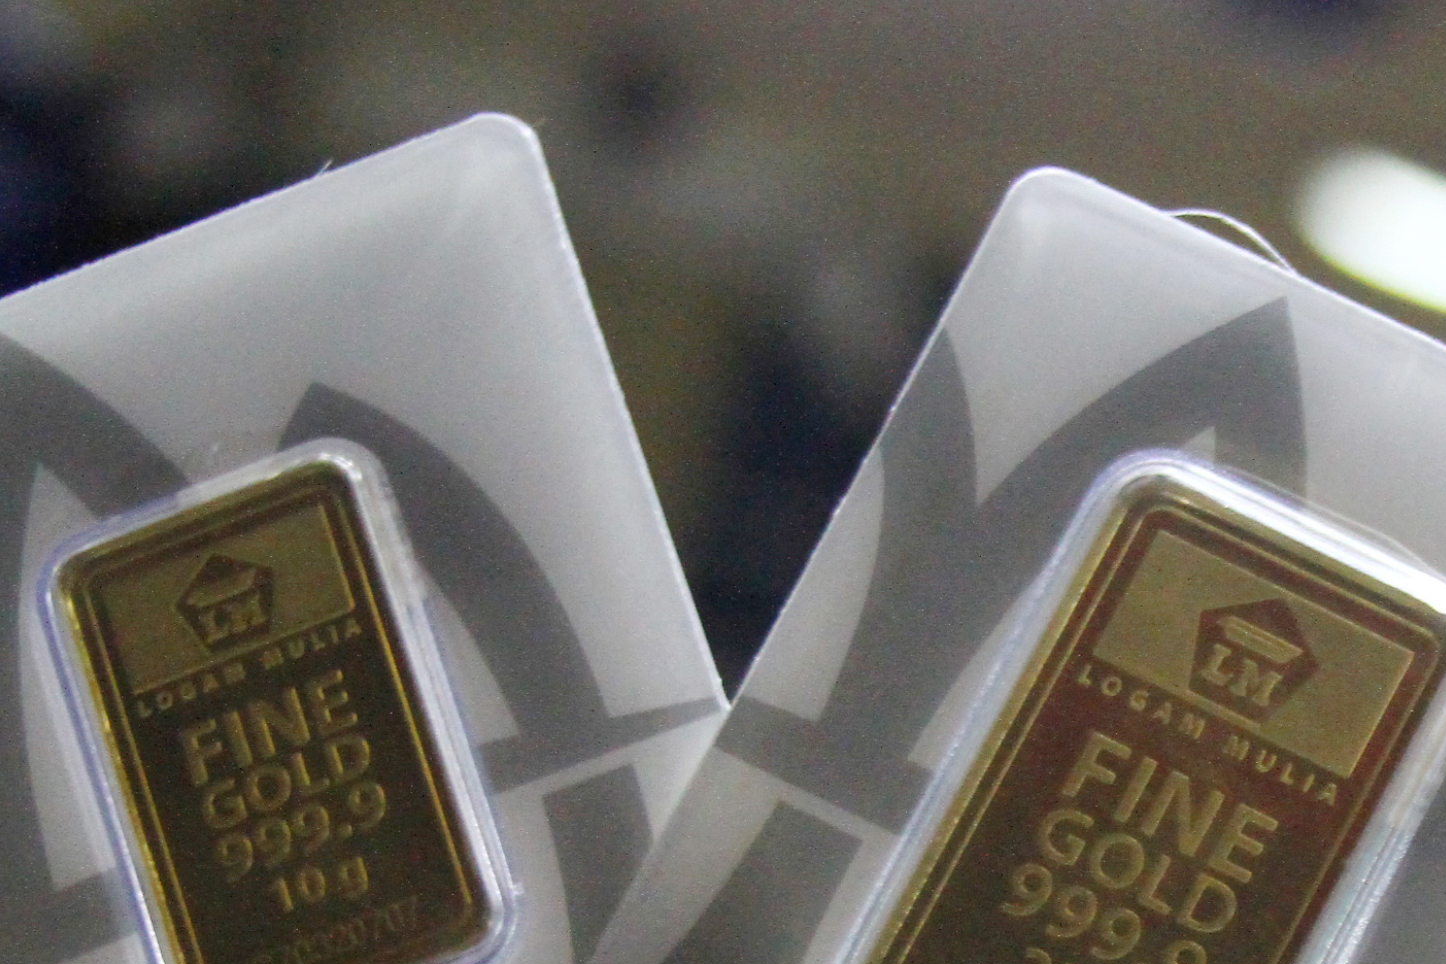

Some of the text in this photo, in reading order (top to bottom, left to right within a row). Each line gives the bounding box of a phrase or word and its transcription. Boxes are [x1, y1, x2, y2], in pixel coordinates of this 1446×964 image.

[138, 618, 362, 719] LOGAM MULIA
[180, 668, 359, 787] FINE
[203, 734, 370, 829] GOLD
[1077, 664, 1339, 807] LOGAM MULIA
[213, 781, 387, 885] 999.9
[1061, 731, 1279, 884] FINE
[274, 856, 369, 913] 10 g
[1039, 809, 1238, 933] GOLD
